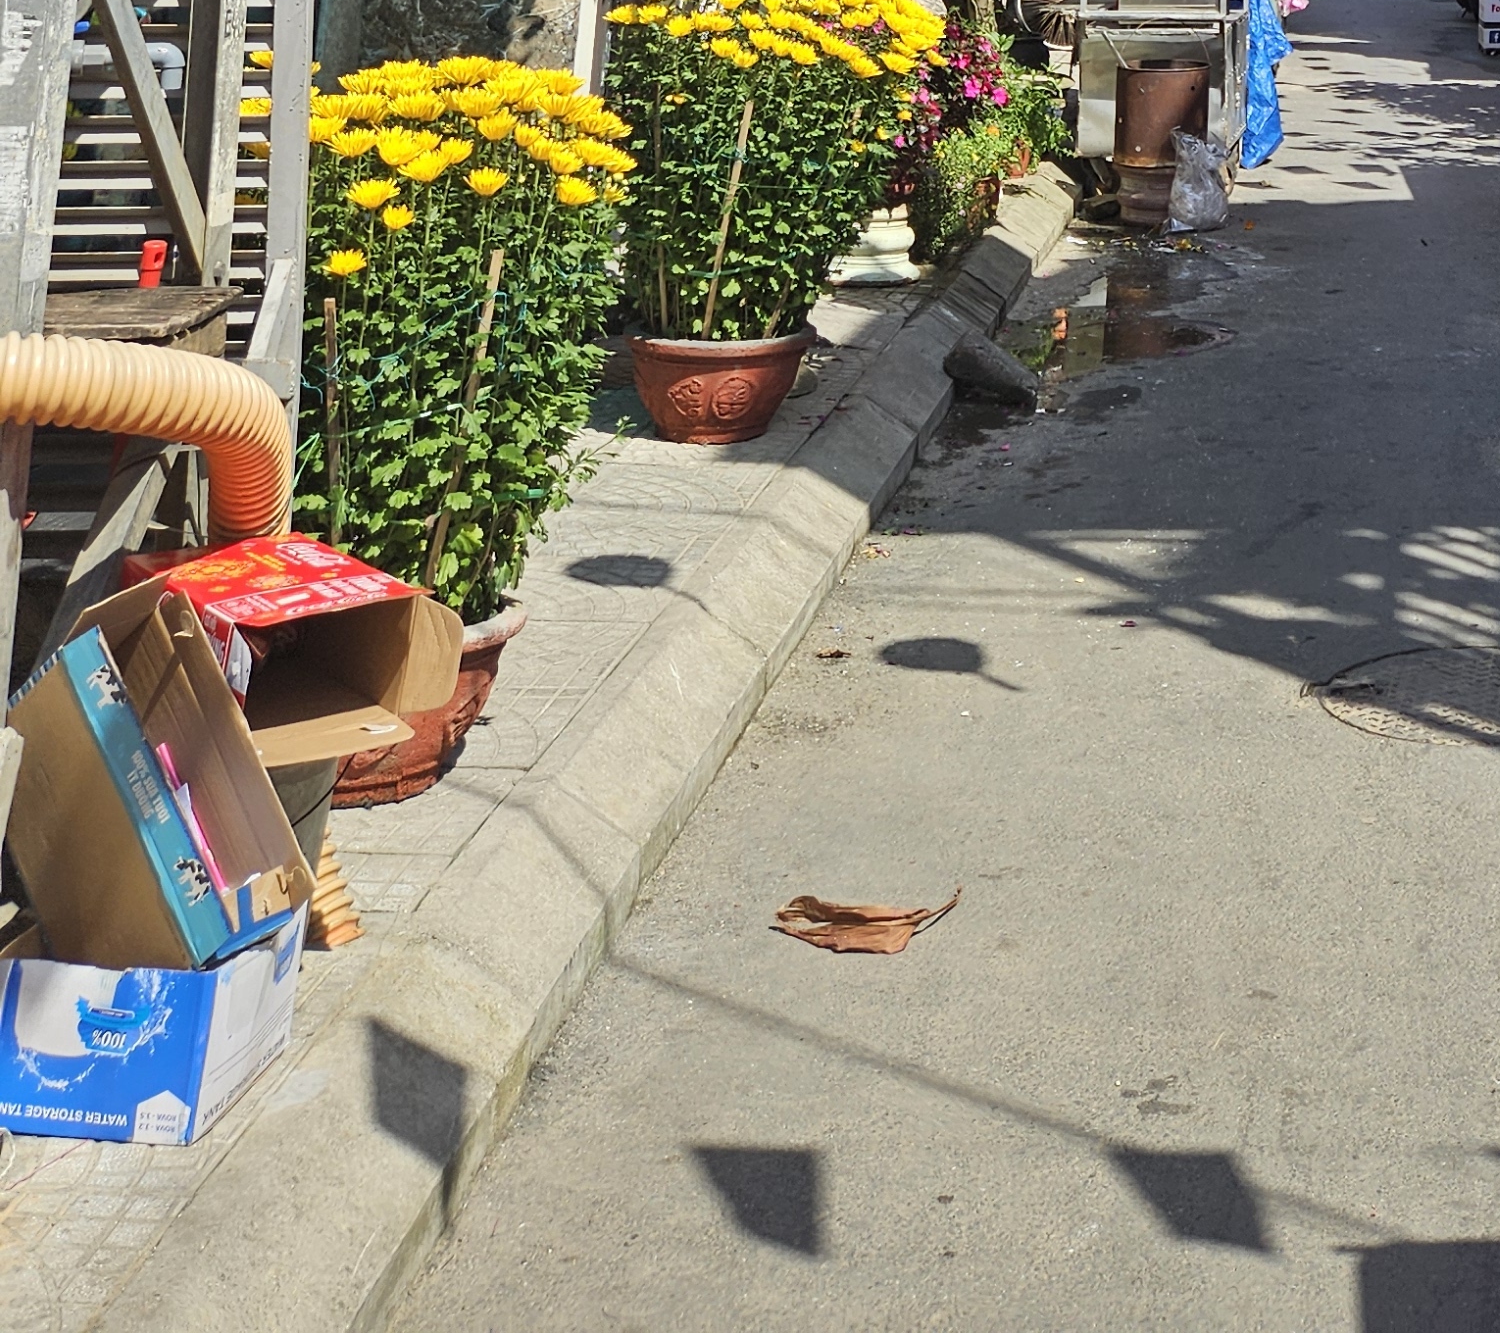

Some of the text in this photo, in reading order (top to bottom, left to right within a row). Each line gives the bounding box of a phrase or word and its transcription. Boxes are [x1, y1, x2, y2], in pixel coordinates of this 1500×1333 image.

[92, 1029, 128, 1050] 100%
[0, 1101, 128, 1127] WATER STORAGE TAN
